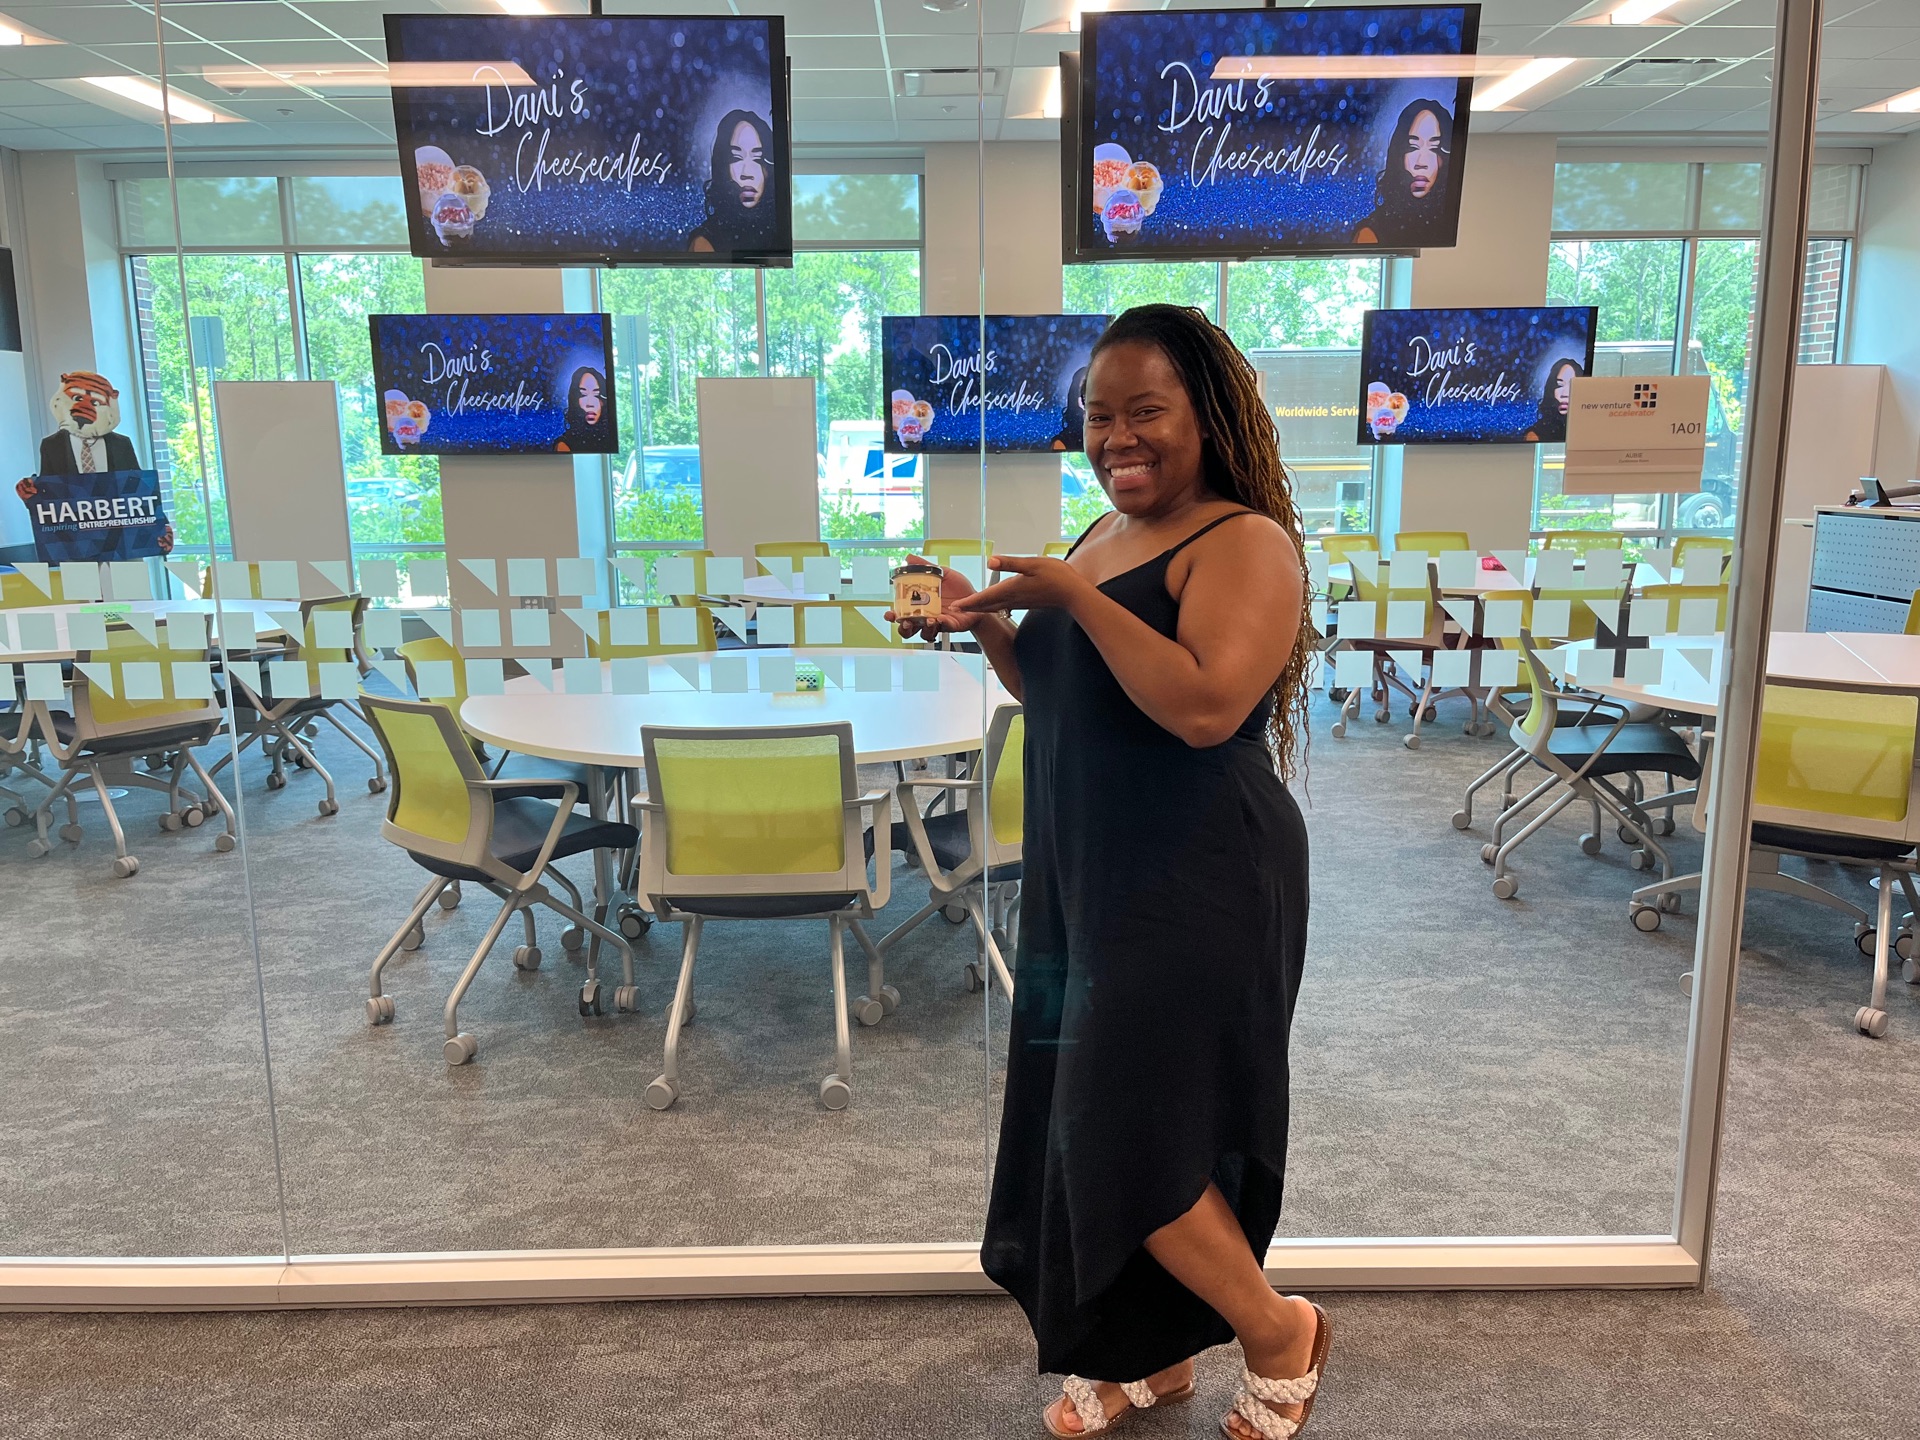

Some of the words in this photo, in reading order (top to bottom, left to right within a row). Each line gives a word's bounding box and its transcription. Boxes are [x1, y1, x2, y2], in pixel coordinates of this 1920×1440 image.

[472, 65, 588, 137] Dani's
[1157, 62, 1275, 133] Dani's
[516, 128, 672, 193] Cheesecakes
[1191, 122, 1348, 188] Cheesecakes
[420, 342, 493, 384] Dani's
[929, 343, 998, 385] Danis
[1406, 336, 1477, 377] Dani's
[446, 378, 544, 417] Cheesecakes
[1425, 370, 1521, 409] Cheesecakes
[1600, 402, 1632, 410] venture
[1275, 406, 1329, 417] Worldwide
[1608, 410, 1656, 418] accelerator
[1670, 422, 1701, 435] 1A01
[36, 495, 158, 525] HARBERT
[41, 522, 78, 533] inspiring
[78, 516, 157, 530] ENTREPRENEURSHIP
